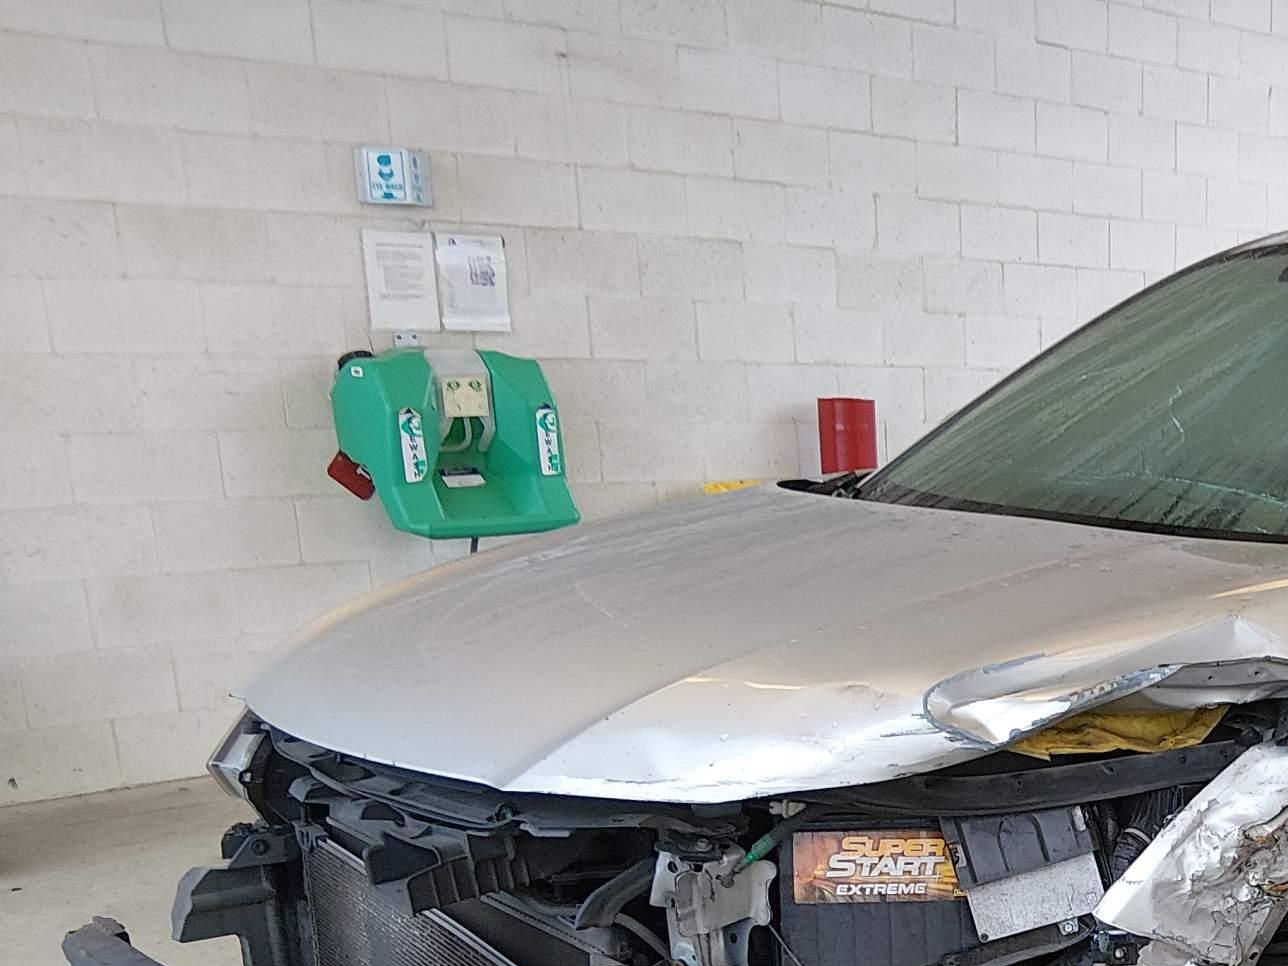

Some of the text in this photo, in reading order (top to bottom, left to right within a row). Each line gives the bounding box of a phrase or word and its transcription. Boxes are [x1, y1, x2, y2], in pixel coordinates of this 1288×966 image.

[840, 836, 946, 856] SUPER
[826, 855, 946, 877] START
[836, 883, 927, 895] EXTREME
